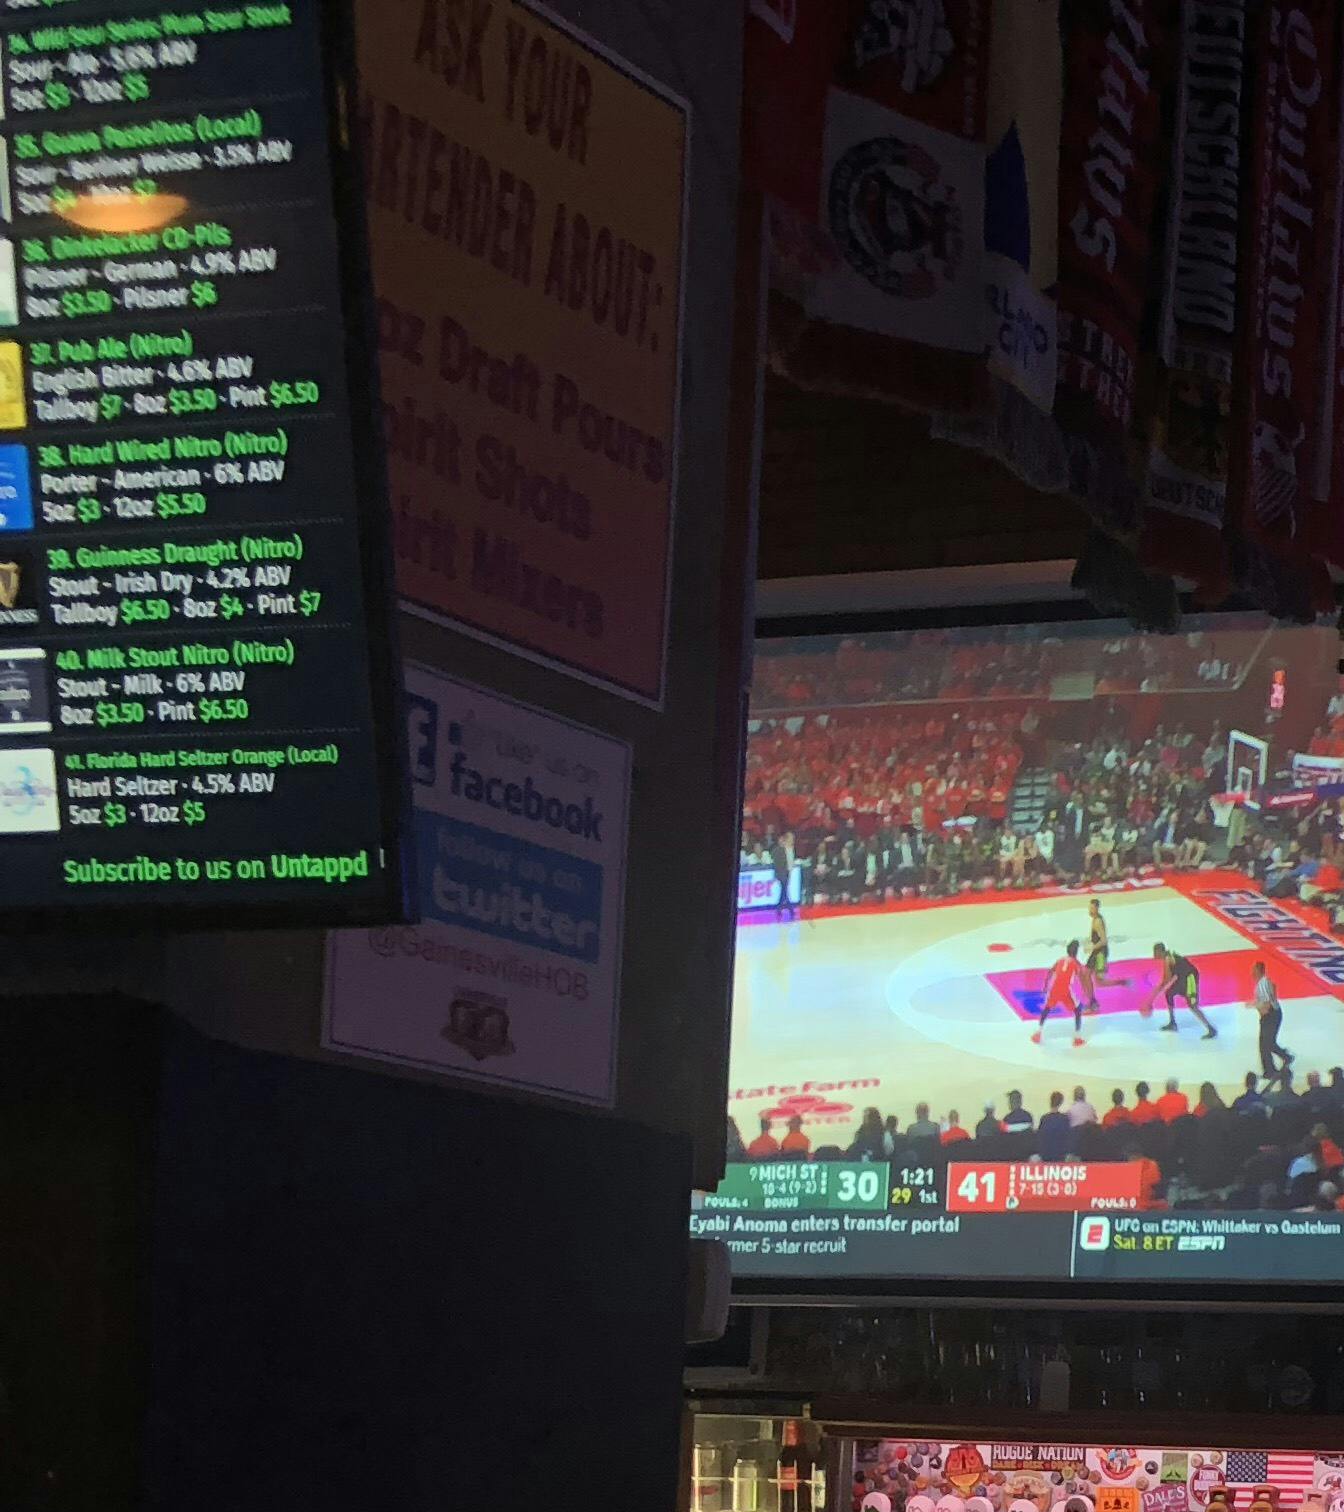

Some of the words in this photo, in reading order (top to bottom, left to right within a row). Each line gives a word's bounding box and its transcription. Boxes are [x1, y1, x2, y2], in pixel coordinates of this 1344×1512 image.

[414, 0, 493, 105] ASK
[505, 15, 594, 167] YOUR
[544, 202, 664, 353] ABOUT:
[97, 336, 128, 359] Ale
[130, 329, 193, 360] (Nitro)
[101, 364, 154, 388] Bitter
[167, 358, 213, 383] 4.6%
[215, 355, 253, 379] ABV
[168, 387, 217, 415] $3.50
[229, 384, 267, 408] Pint
[269, 379, 319, 408] $6.50
[440, 315, 542, 422] Draft
[553, 373, 666, 485] Pours
[68, 441, 114, 465] Hard
[116, 437, 171, 463] Wired
[173, 434, 222, 459] Nitro
[224, 427, 288, 459] (Nitro)
[40, 473, 98, 495] Porter
[113, 467, 201, 490] American
[213, 461, 244, 484] 6%
[247, 458, 285, 482] ABV
[475, 432, 594, 542] Shots
[42, 501, 76, 523] 5oz
[77, 496, 102, 524] $3
[113, 496, 155, 518] 12oz
[156, 491, 207, 520] $5.50
[76, 545, 162, 568] Guinness
[163, 540, 239, 567] Draught
[240, 533, 303, 563] (Nitro)
[49, 575, 100, 597] Stout
[114, 571, 158, 593] Irish
[160, 569, 193, 595] Dry
[205, 566, 251, 589] 4.2%
[254, 564, 291, 587] ABV
[51, 602, 119, 627] Tallboy
[120, 597, 170, 626] $6.50
[183, 597, 218, 619] 8oz
[219, 592, 244, 620] $4
[257, 592, 297, 615] Pint
[300, 590, 321, 617] $7
[87, 648, 126, 669] Milk
[128, 646, 180, 668] Stout
[182, 643, 230, 666] Nitro
[232, 637, 295, 667] (Nitro)
[57, 676, 109, 699] Stout
[123, 673, 164, 696] Milk
[175, 671, 206, 693] 6%
[209, 669, 246, 692] ABV
[60, 704, 94, 726] 8oz
[95, 700, 145, 728] $3.50
[157, 699, 197, 722] Pint
[199, 696, 249, 724] $6.50
[86, 750, 138, 770] Florida
[140, 749, 177, 769] Hard
[178, 747, 230, 767] Seltzer
[232, 745, 287, 768] Orange
[287, 742, 339, 766] (Local)
[66, 775, 112, 799] Hard
[114, 773, 178, 797] Seltzer
[191, 770, 236, 796] 4.5%
[239, 770, 276, 794] ABV
[450, 750, 603, 842] facebook
[69, 803, 103, 826] 5oz
[103, 799, 128, 829] $3
[138, 800, 181, 825] 12oz
[182, 797, 206, 827] $5
[63, 854, 173, 885] Subscribe
[176, 855, 200, 882] to
[205, 858, 233, 880] us
[236, 856, 266, 878] on
[271, 848, 369, 883] Untappd
[431, 862, 598, 951] twitter
[759, 1164, 797, 1182] MICH
[800, 1164, 820, 1181] ST
[837, 1170, 879, 1202] 30
[900, 1168, 935, 1186] 1:21
[958, 1171, 996, 1203] 41
[1020, 1165, 1087, 1182] ILLINOIS
[891, 1187, 913, 1205] 29
[919, 1188, 938, 1205] 1st
[689, 1214, 730, 1234] Eyabi
[733, 1215, 788, 1233] Anoma
[791, 1215, 840, 1233] enters
[843, 1213, 907, 1232] transfer
[911, 1214, 960, 1235] portal
[1114, 1218, 1141, 1233] UFC
[1143, 1221, 1159, 1232] on
[1162, 1219, 1200, 1233] ESPN:
[1202, 1219, 1262, 1234] Whittaker
[1265, 1223, 1279, 1235] vs
[1281, 1220, 1342, 1235] Gastelum
[761, 1238, 801, 1254] 5-star
[804, 1237, 848, 1253] recruit
[1155, 1236, 1174, 1250] ET
[1178, 1235, 1226, 1251] ESPN
[1038, 1446, 1085, 1462] NATION
